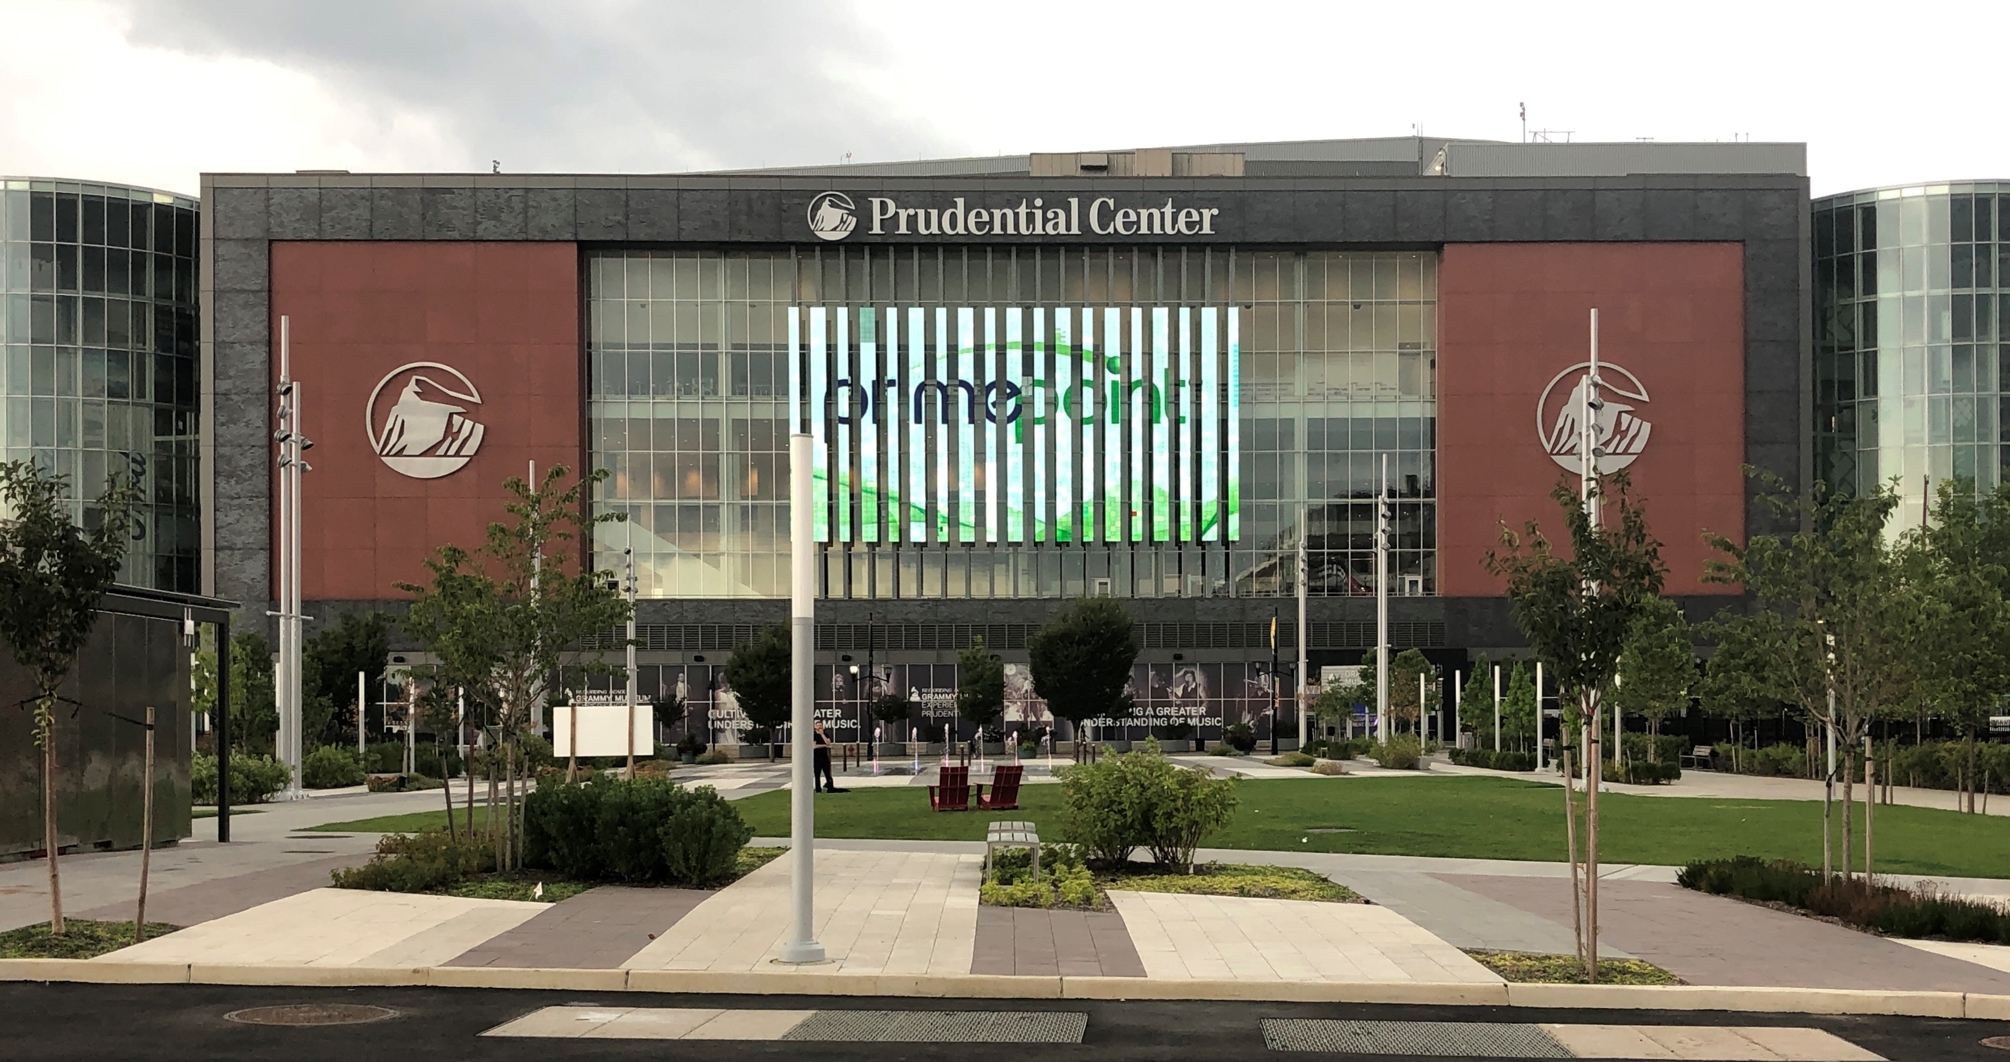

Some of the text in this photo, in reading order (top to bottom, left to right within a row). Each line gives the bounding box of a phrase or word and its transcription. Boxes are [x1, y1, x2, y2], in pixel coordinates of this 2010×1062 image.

[867, 197, 1219, 236] Prudential Center
[824, 356, 1186, 444] prmepoint
[921, 693, 957, 701] GRAMMY
[1145, 707, 1155, 716] A
[1156, 707, 1206, 716] GREATER
[1081, 717, 1168, 727] NDERSTANDING
